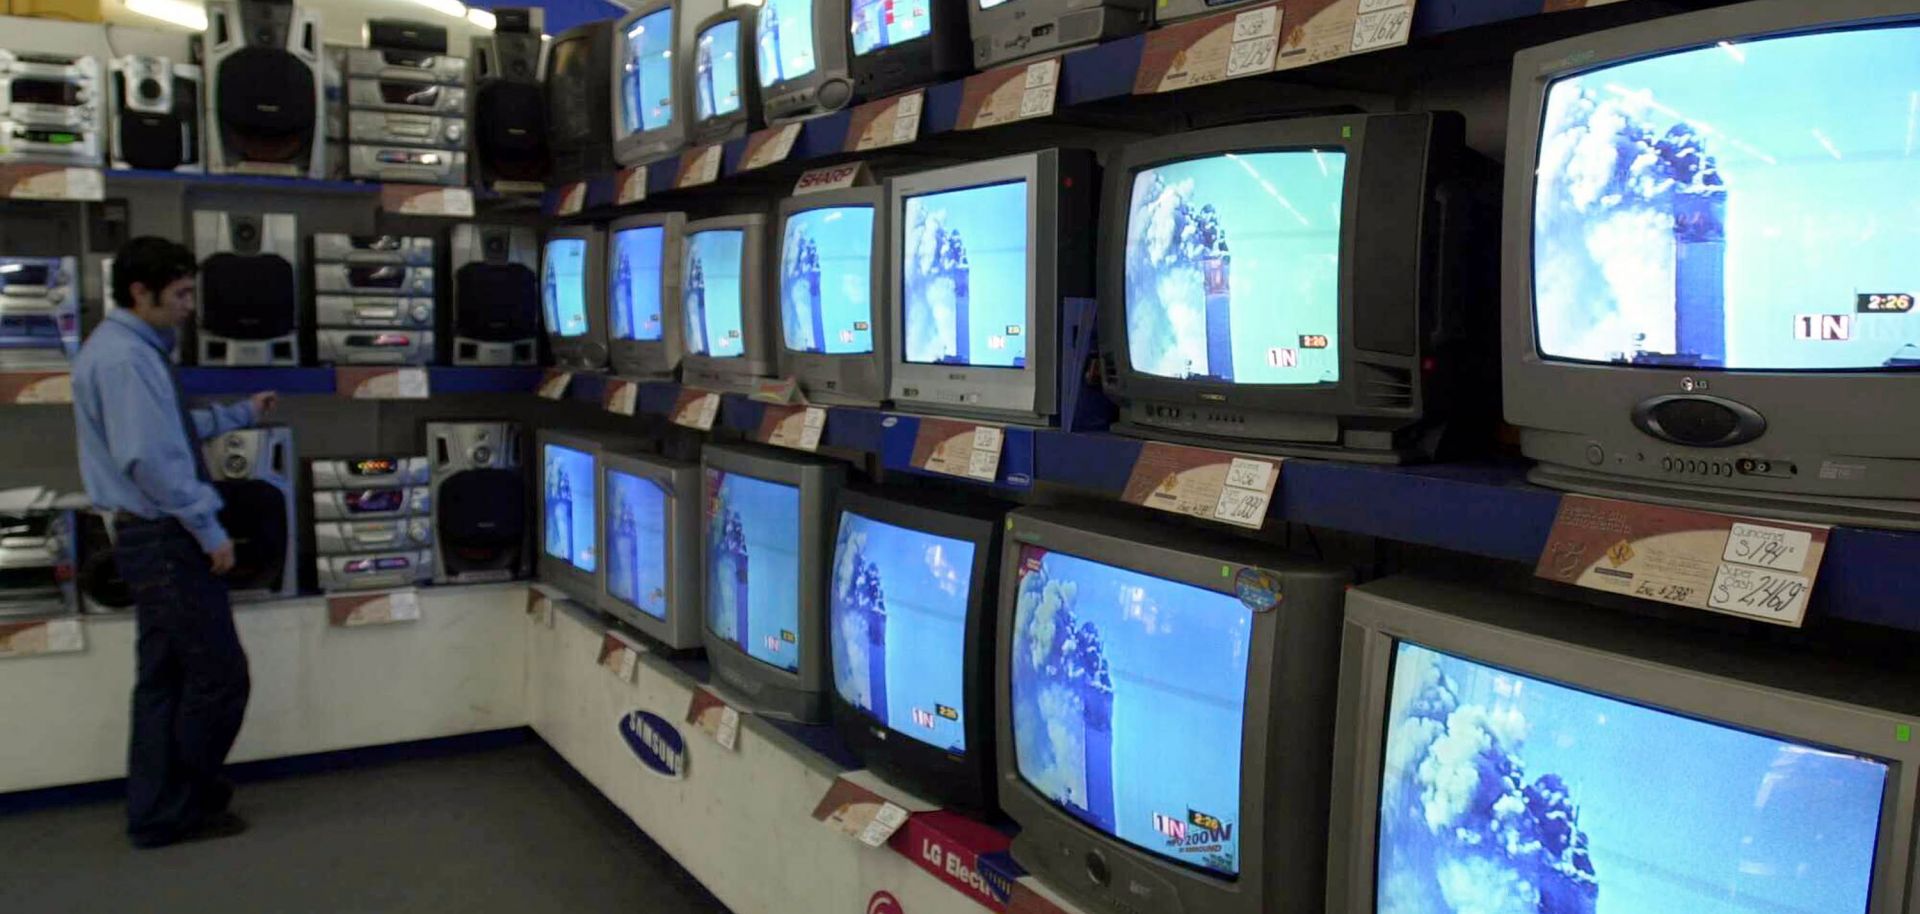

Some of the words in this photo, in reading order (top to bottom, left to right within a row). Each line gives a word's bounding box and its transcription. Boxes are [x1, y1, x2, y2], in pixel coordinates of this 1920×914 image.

[799, 167, 855, 188] SHARP
[1867, 294, 1909, 311] 2:26
[629, 711, 682, 774] SAMSUNG
[922, 838, 942, 867] LG
